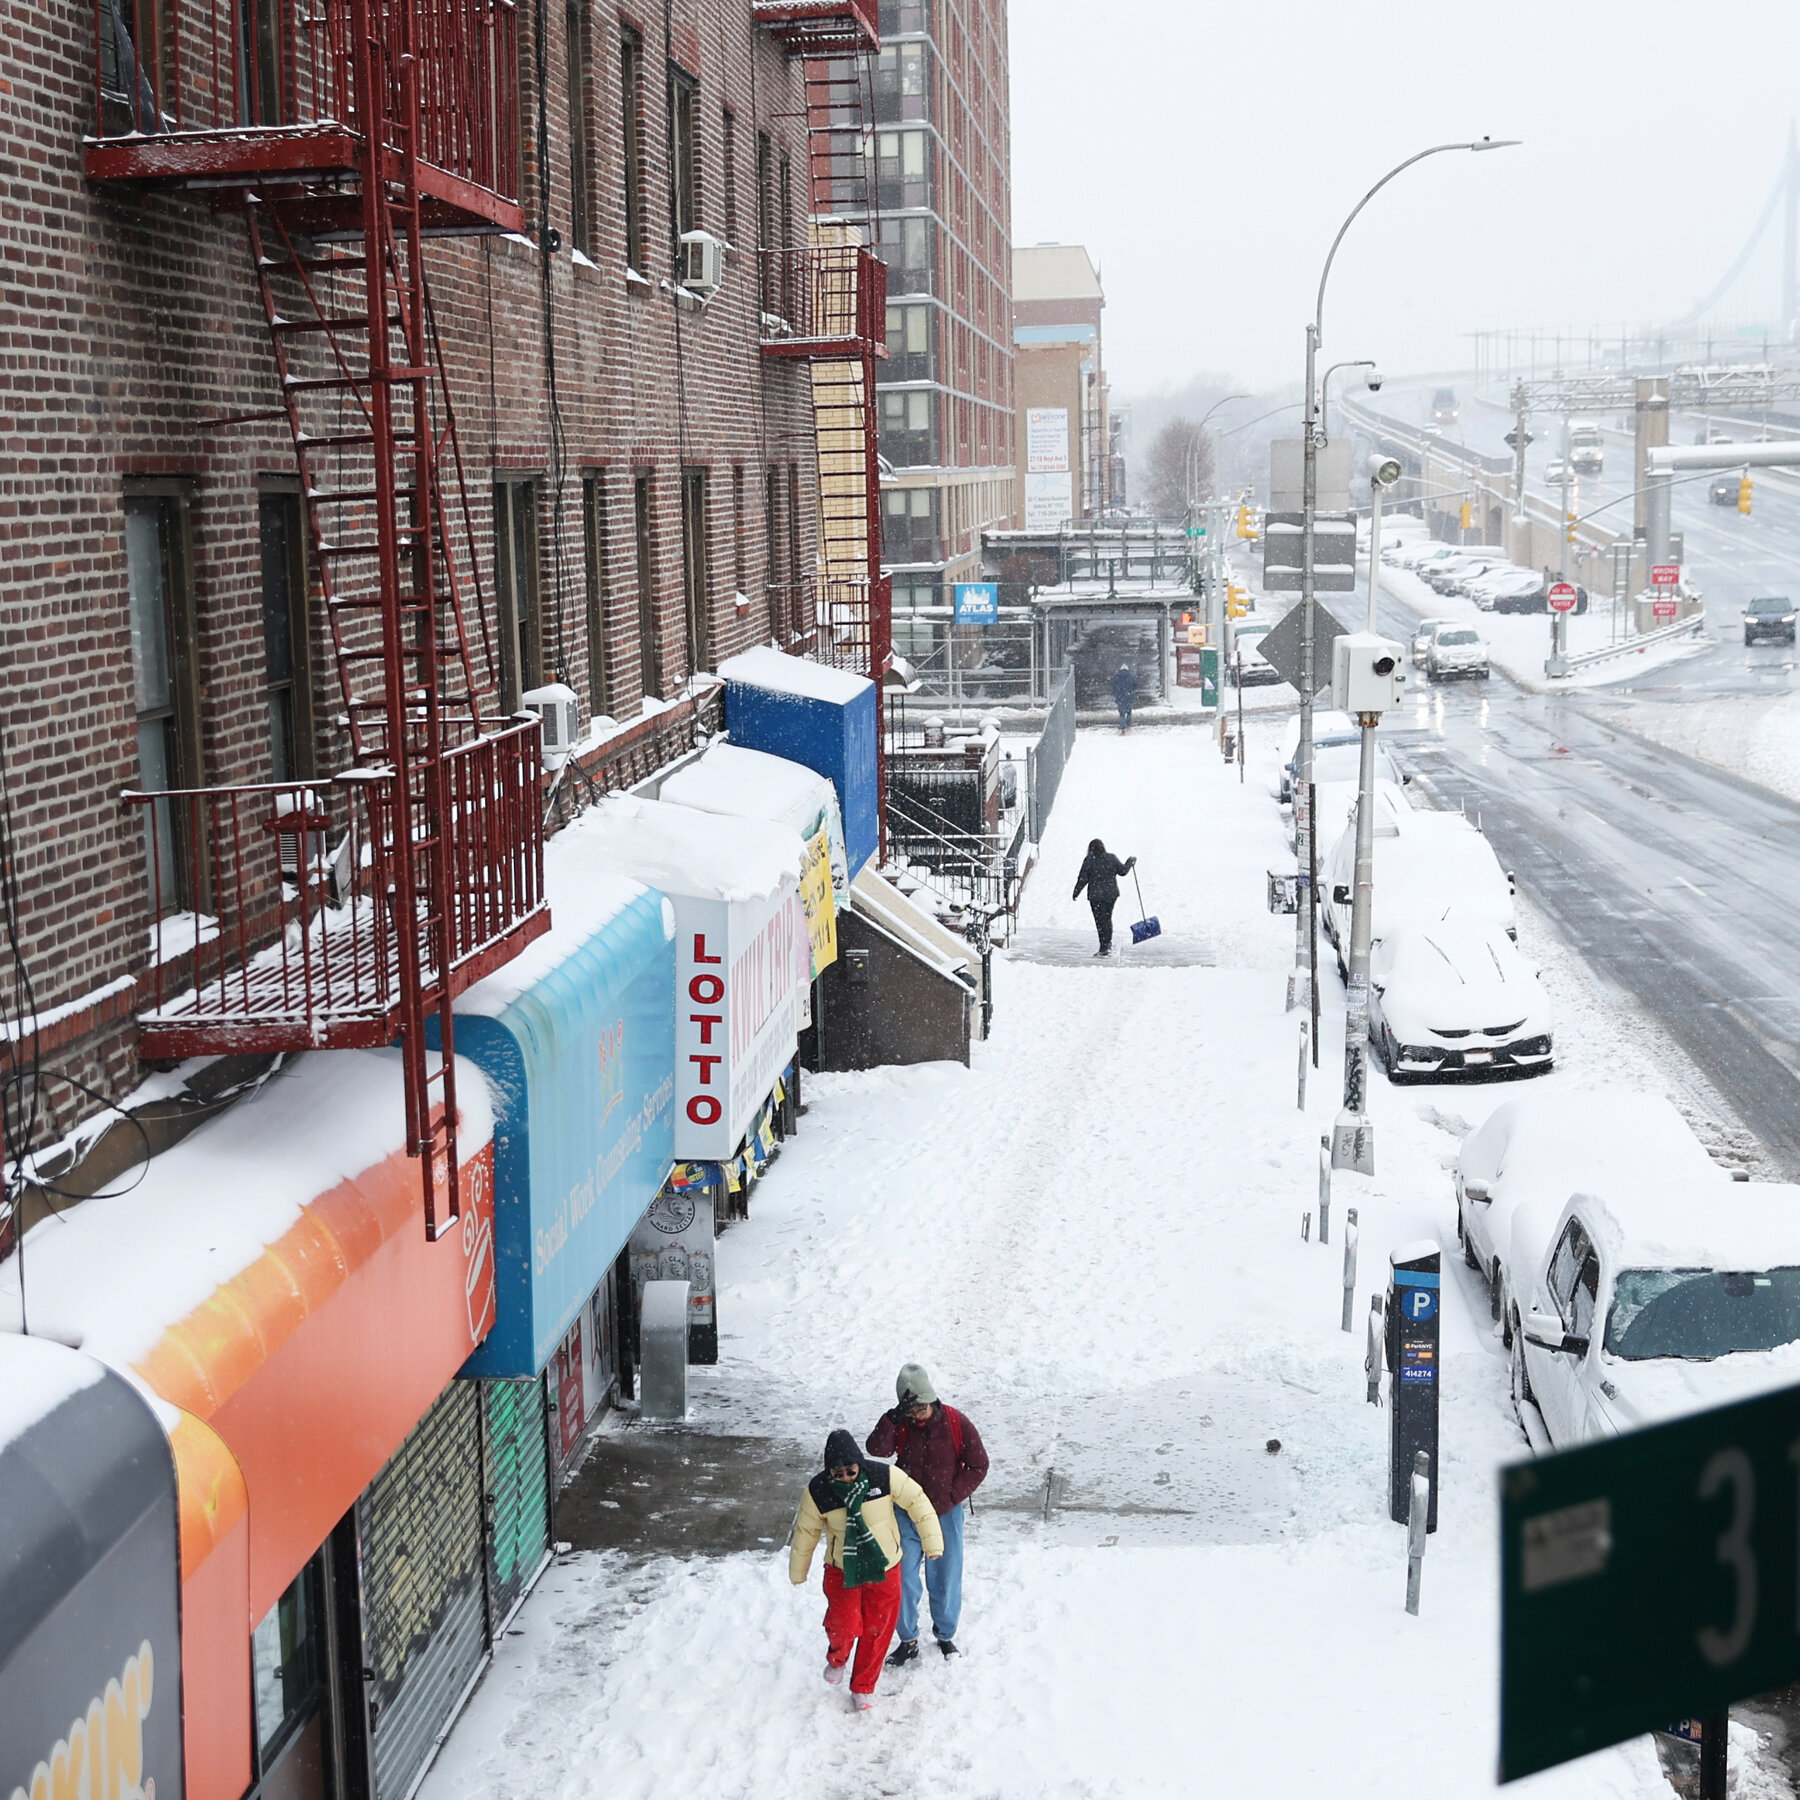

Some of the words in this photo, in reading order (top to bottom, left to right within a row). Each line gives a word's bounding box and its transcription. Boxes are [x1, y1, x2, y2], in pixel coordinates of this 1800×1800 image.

[959, 604, 994, 613] ATLAS
[732, 928, 766, 1070] KWIK
[767, 896, 794, 1014] TRIP
[686, 933, 725, 1126] LOTTO
[536, 1198, 569, 1277] Social
[570, 1168, 595, 1231] Work
[596, 1110, 644, 1196] Counseling
[643, 1072, 674, 1132] Services
[656, 1221, 674, 1231] HARD
[675, 1207, 693, 1231] SELTZER
[1413, 1292, 1431, 1317] P
[1405, 1370, 1432, 1378] 414274
